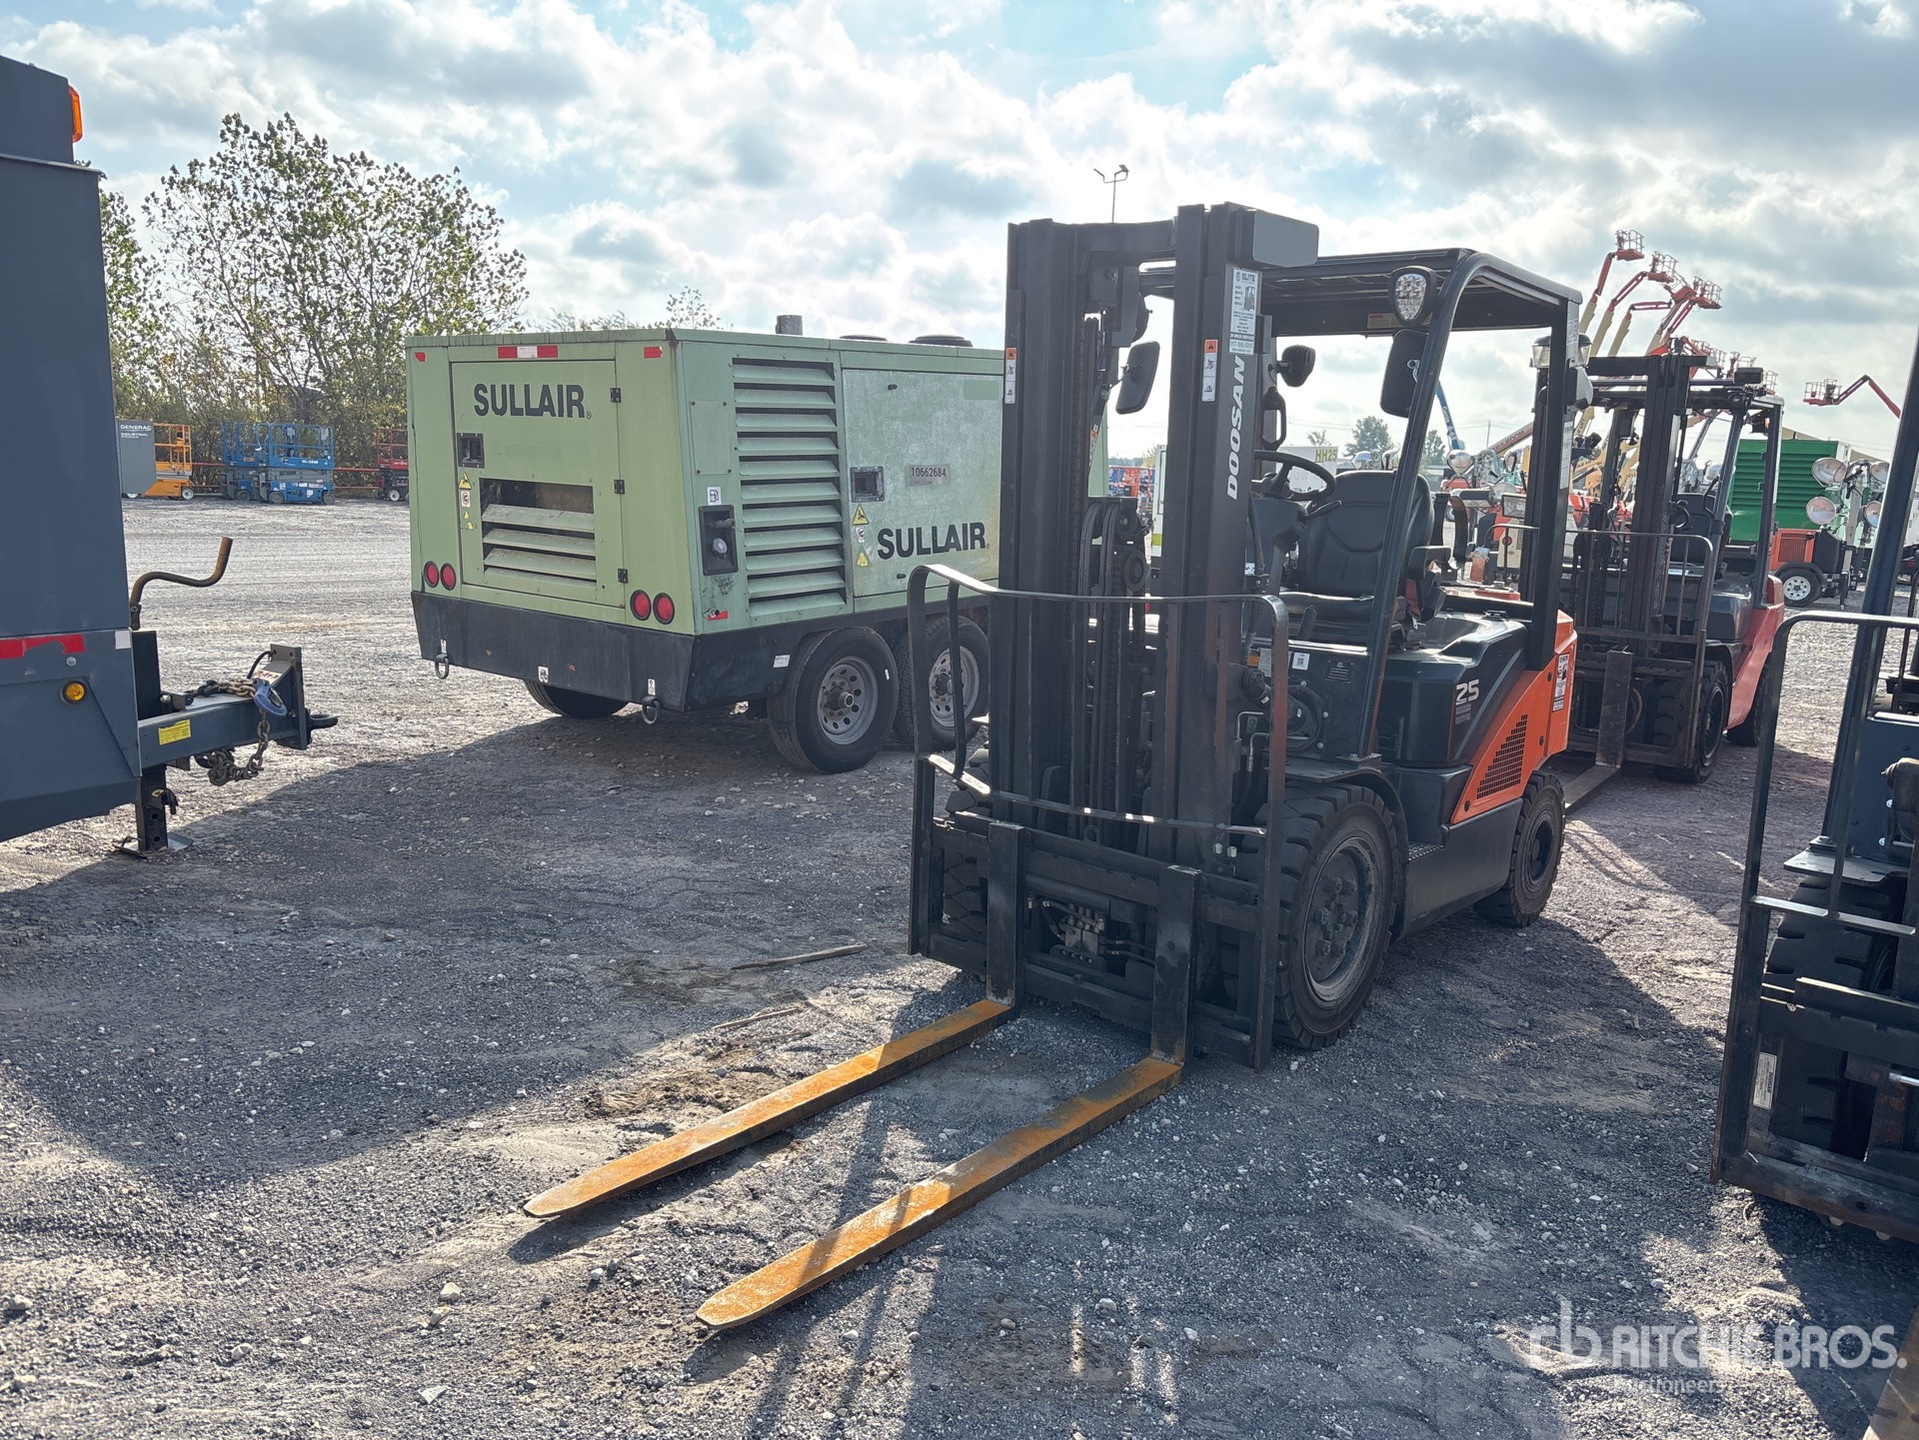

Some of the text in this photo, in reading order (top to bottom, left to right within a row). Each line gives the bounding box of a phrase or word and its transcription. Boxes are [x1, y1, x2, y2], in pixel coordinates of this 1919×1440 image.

[473, 383, 585, 418] SULLAIR
[1227, 355, 1245, 500] DOOSAN
[1315, 449, 1338, 462] HH25
[911, 467, 947, 477] 10662684
[877, 522, 986, 560] SULLAIR
[1455, 679, 1480, 705] 25
